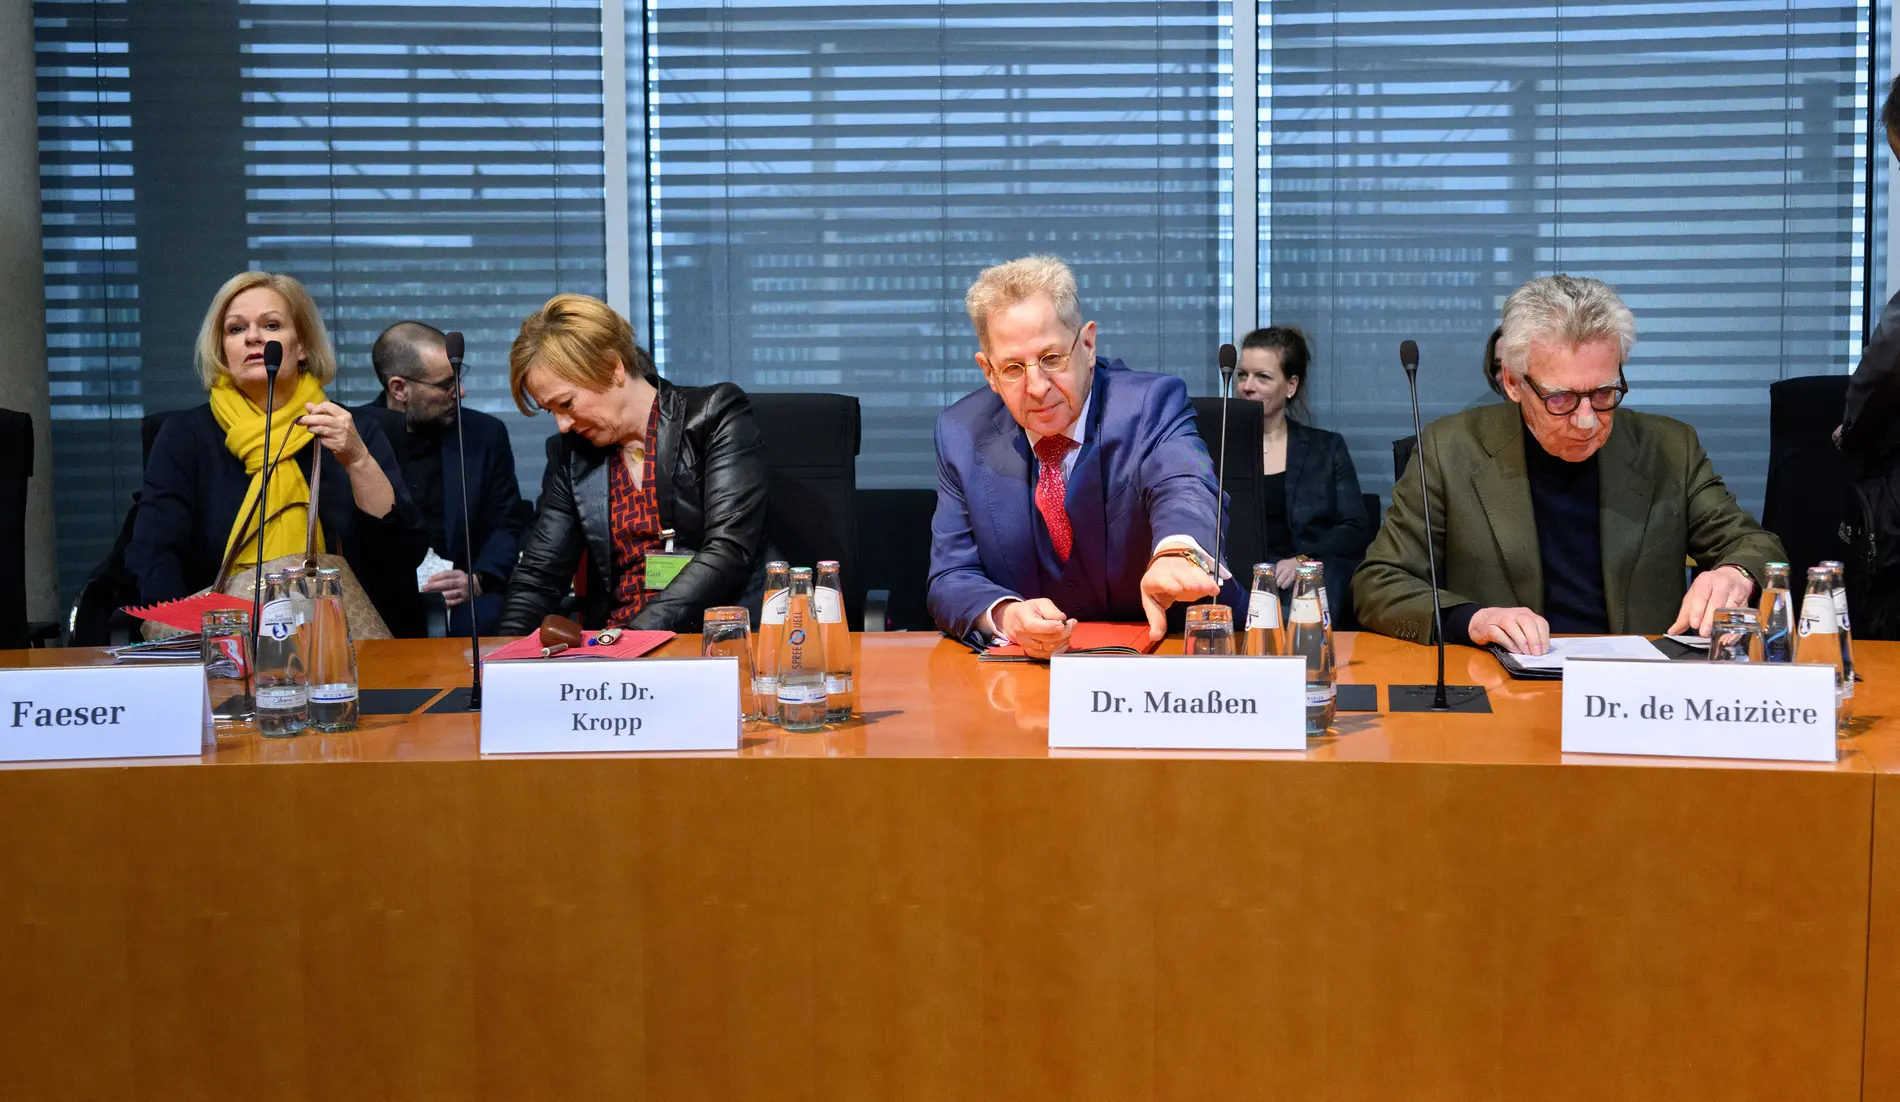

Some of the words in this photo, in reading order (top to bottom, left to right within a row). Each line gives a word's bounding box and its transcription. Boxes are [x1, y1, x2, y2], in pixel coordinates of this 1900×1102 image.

[559, 681, 613, 702] Prof.
[620, 682, 654, 701] Dr.
[1091, 690, 1133, 713] Dr.
[1144, 690, 1257, 714] Maaßen
[10, 700, 126, 728] Faeser
[1585, 695, 1628, 719] Dr.
[1640, 695, 1674, 721] de
[1684, 698, 1817, 724] Maizière
[571, 712, 642, 736] Kropp
